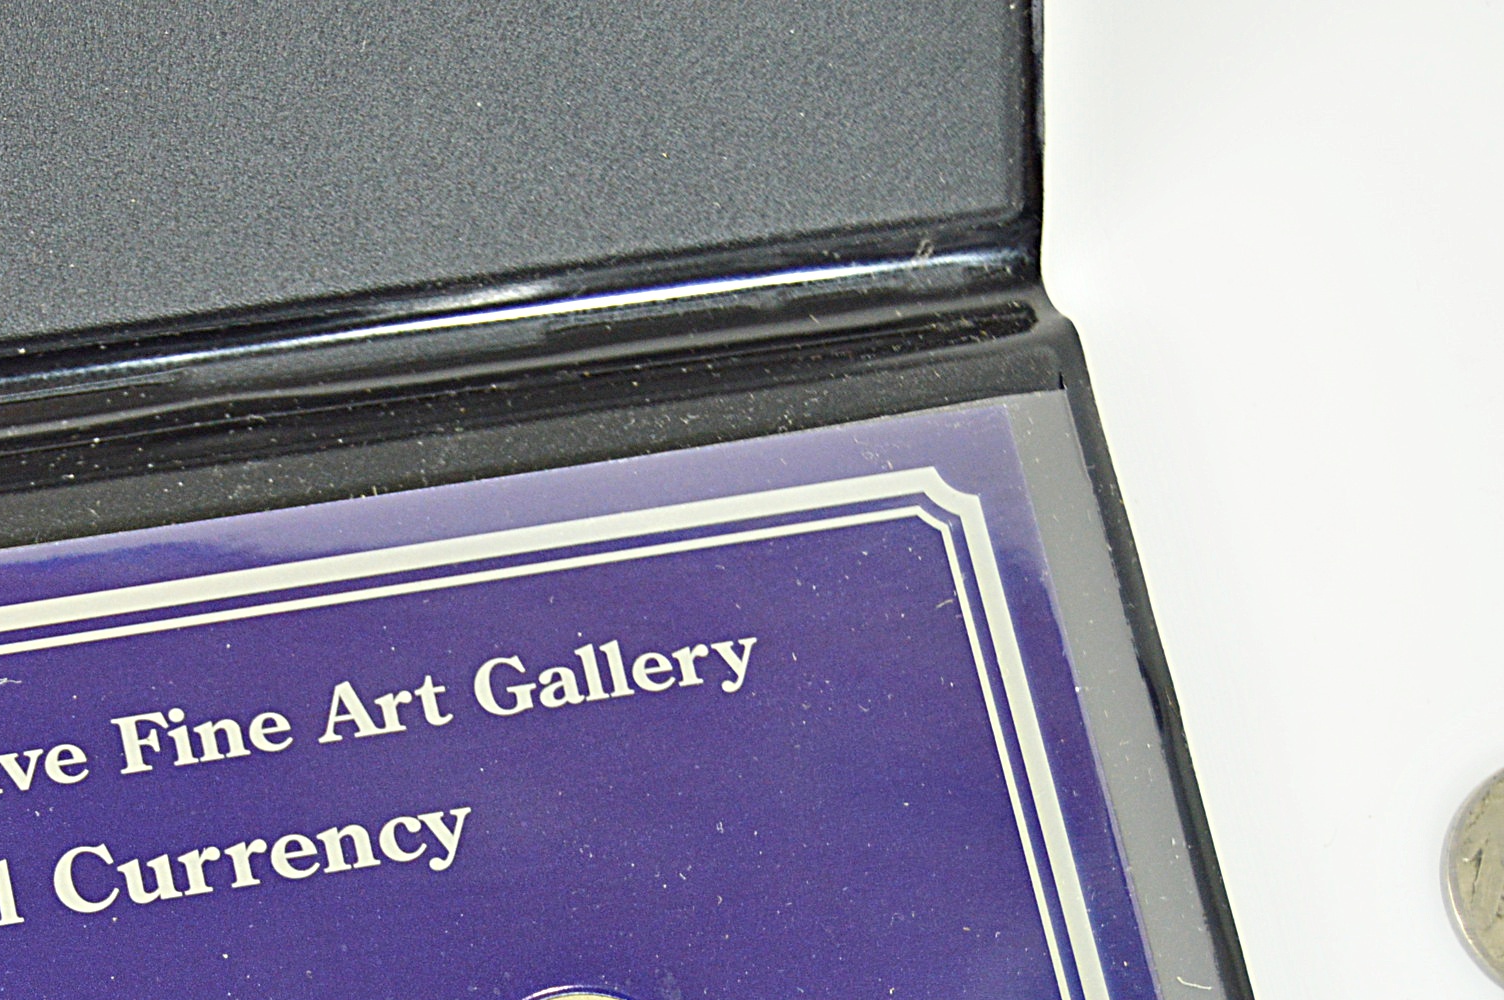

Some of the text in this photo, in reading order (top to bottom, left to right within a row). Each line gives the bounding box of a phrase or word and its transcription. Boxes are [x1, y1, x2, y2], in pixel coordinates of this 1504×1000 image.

[110, 706, 294, 775] Fine
[317, 674, 454, 744] Art
[473, 636, 758, 716] Gallery
[53, 806, 472, 913] Currency
